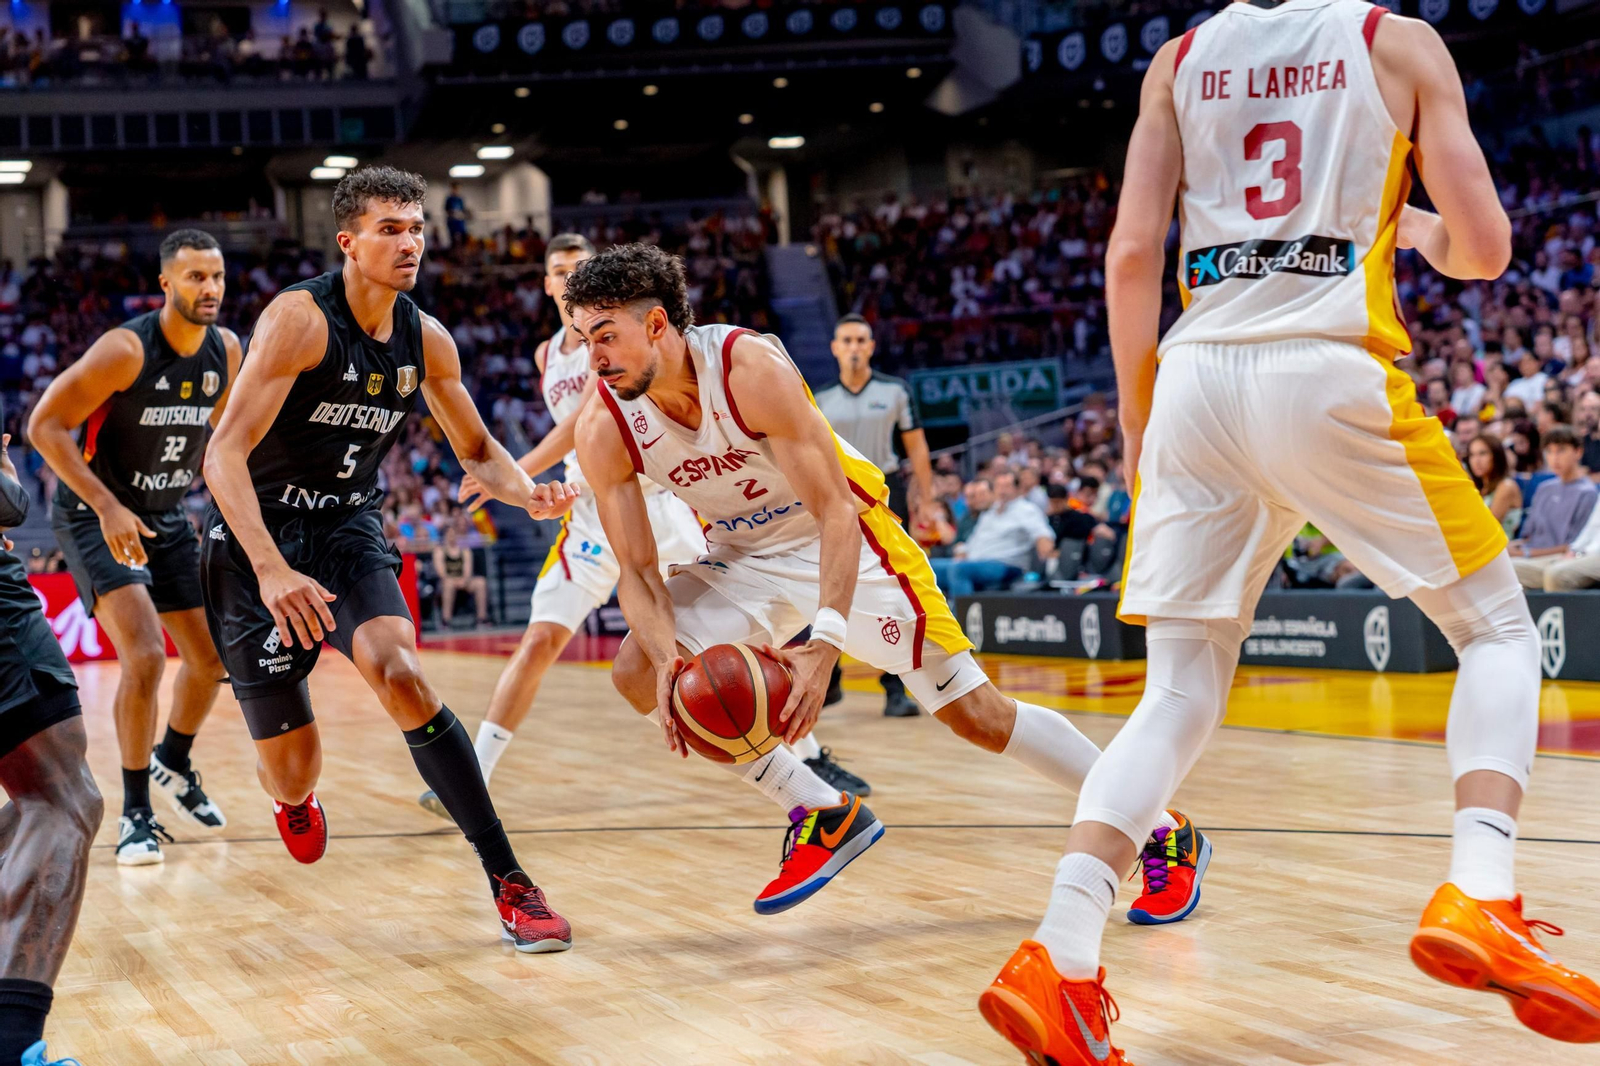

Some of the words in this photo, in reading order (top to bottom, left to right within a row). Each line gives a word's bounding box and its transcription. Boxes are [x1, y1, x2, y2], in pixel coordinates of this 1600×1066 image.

[1201, 70, 1232, 101] DE
[1247, 59, 1347, 99] LARREA
[1243, 120, 1303, 221] 3
[921, 368, 1050, 405] SALIDA
[160, 436, 187, 462] 32
[336, 443, 362, 479] 5
[131, 470, 169, 492] ING
[733, 478, 769, 501] 2
[258, 652, 294, 668] Domino's
[268, 664, 291, 675] Pizza
